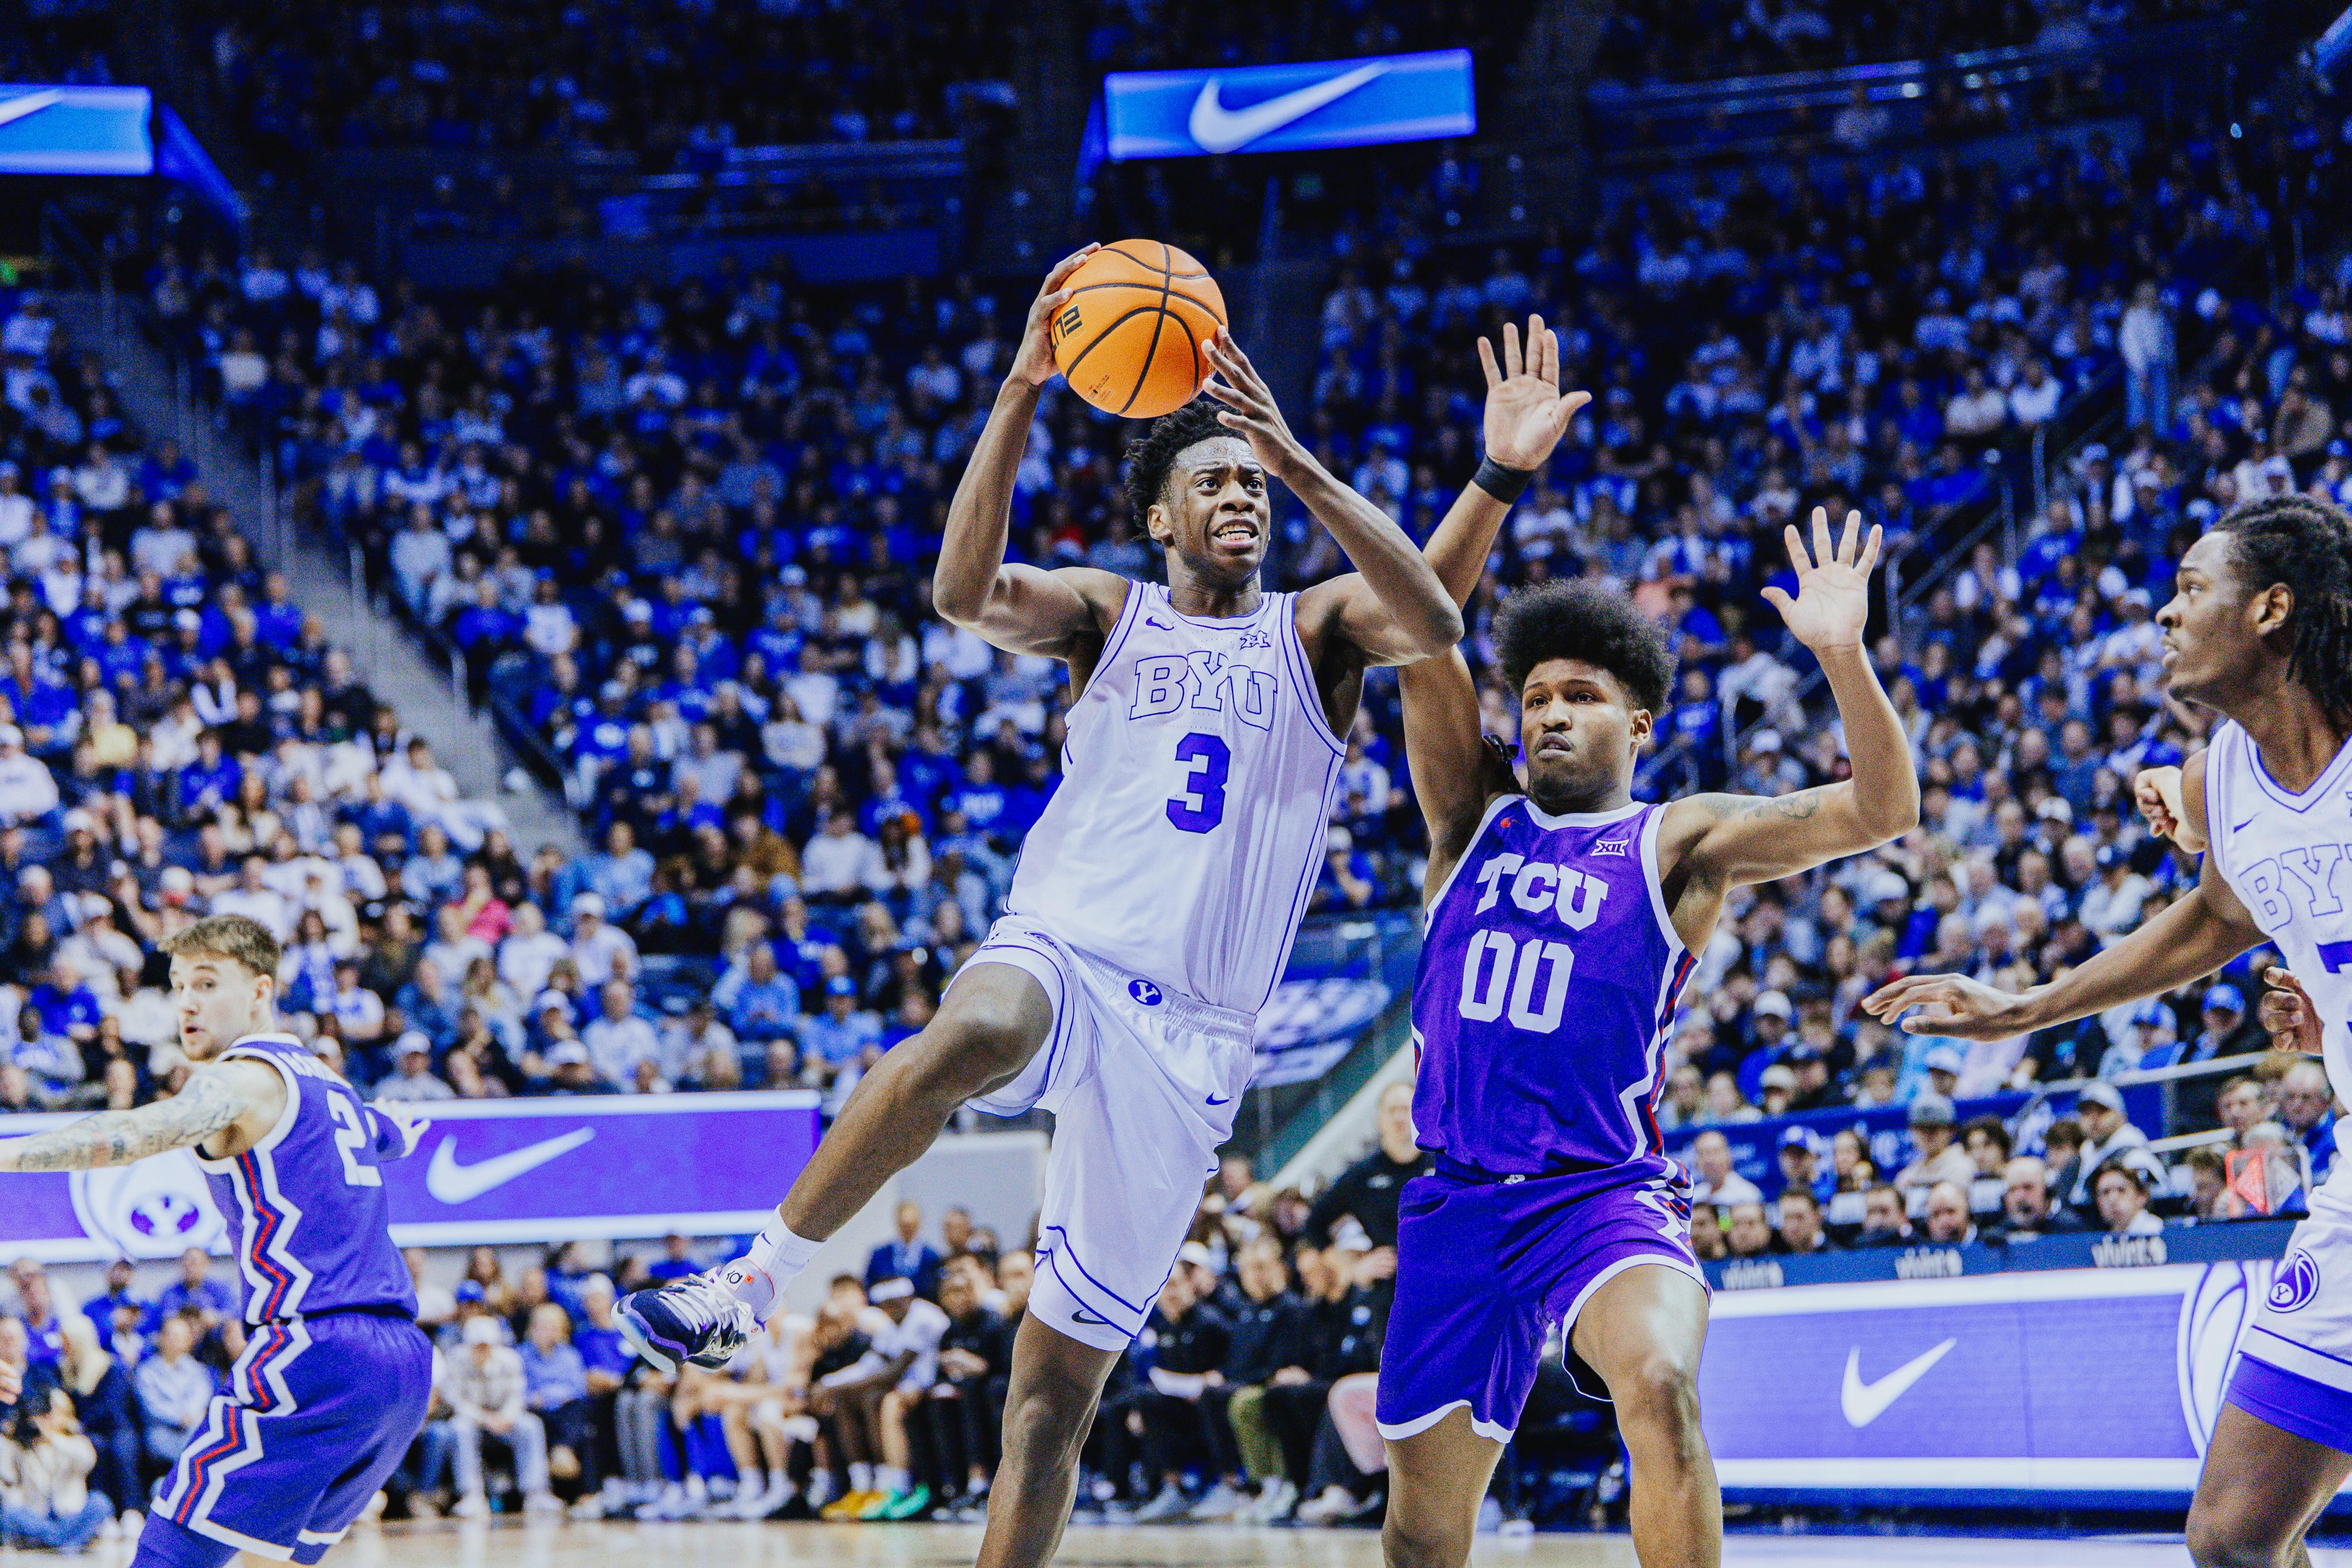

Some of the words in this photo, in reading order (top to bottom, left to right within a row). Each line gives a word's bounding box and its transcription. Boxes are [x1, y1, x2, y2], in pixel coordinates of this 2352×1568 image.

[1129, 651, 1278, 731] BYU
[1166, 732, 1231, 834] 3
[1474, 852, 1609, 931] TCU
[2238, 843, 2352, 932] BY
[1458, 929, 1575, 1034] 00
